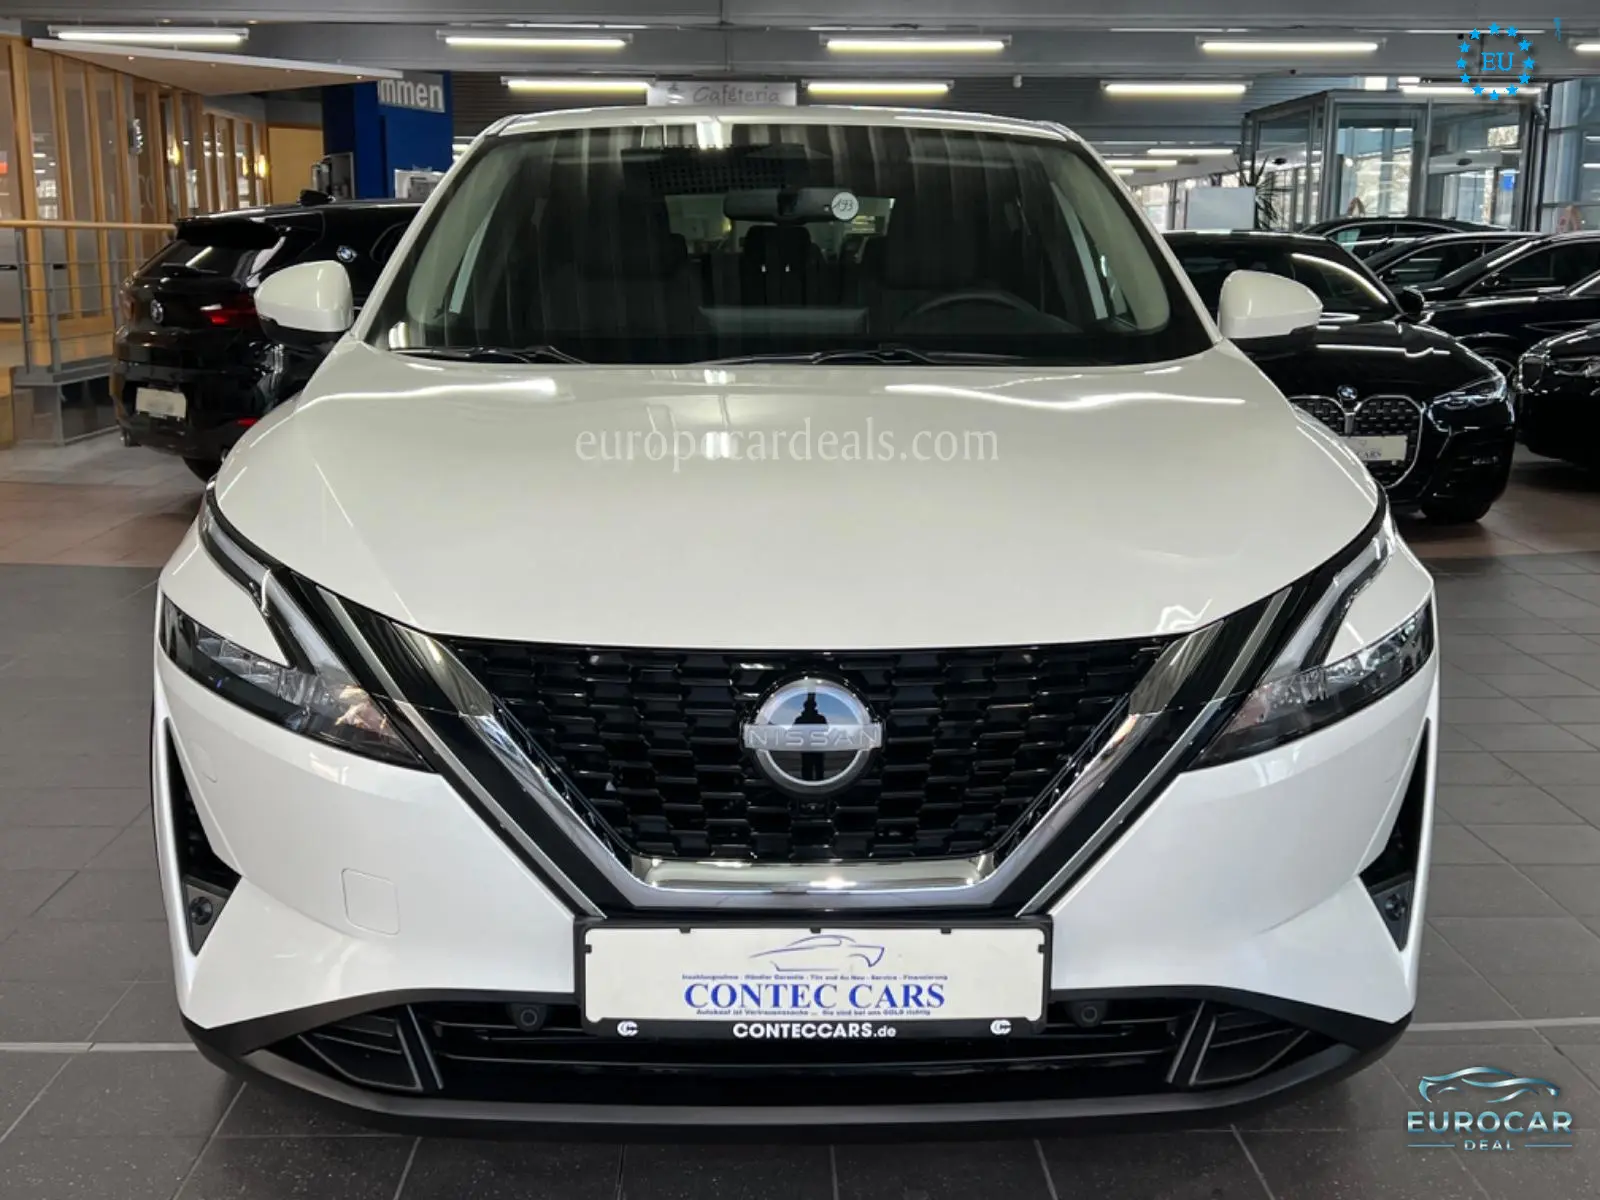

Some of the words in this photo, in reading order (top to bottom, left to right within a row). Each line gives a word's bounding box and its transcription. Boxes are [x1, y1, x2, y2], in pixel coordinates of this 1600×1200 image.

[377, 79, 444, 109] mmen
[749, 728, 877, 746] NISSAN
[684, 984, 838, 1009] CONTEC
[848, 984, 945, 1009] CARS
[733, 1023, 897, 1038] CONTECCARS.de
